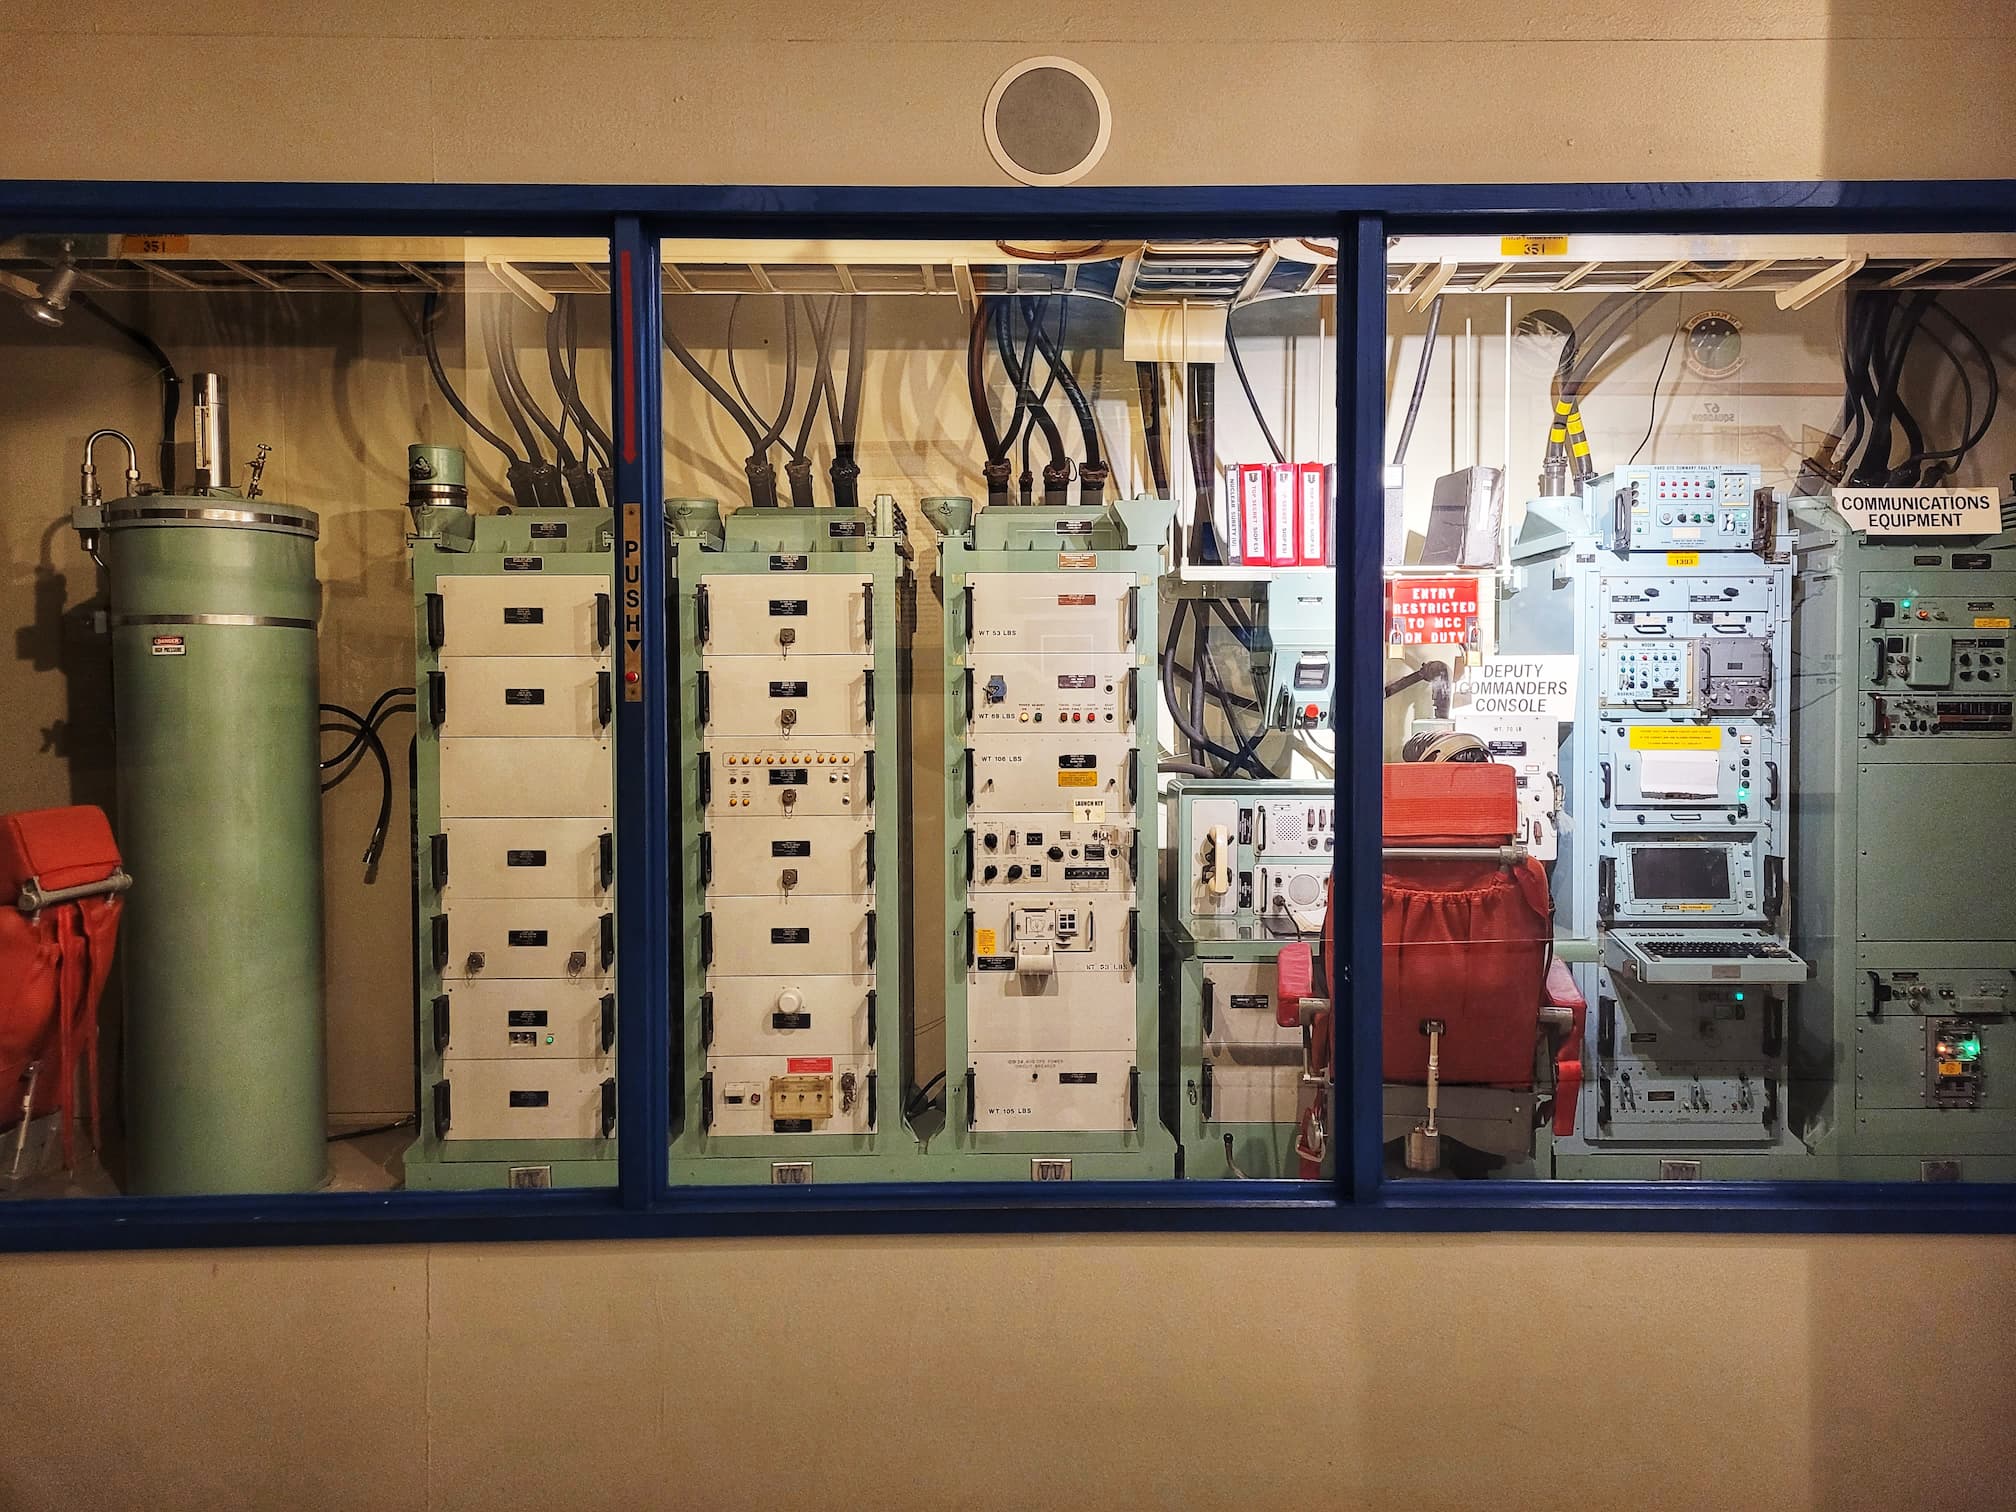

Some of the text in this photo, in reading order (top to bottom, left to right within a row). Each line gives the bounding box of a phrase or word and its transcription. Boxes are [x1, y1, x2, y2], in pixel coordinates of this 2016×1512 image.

[143, 240, 166, 253] 351
[1523, 243, 1545, 255] 351
[1841, 495, 1990, 511] COMMUNICATIONS
[1868, 513, 1963, 530] EQUIPMENT
[625, 540, 640, 632] PUSH
[1412, 587, 1456, 599] ENTRY
[1392, 602, 1476, 615] RESTRICTED
[1407, 617, 1462, 628] TO MCC
[1404, 631, 1465, 644] ON DUTY
[1483, 664, 1544, 678] DEPUTY
[1459, 681, 1568, 695] COMMANDERS
[1475, 698, 1547, 712] CONSOLE
